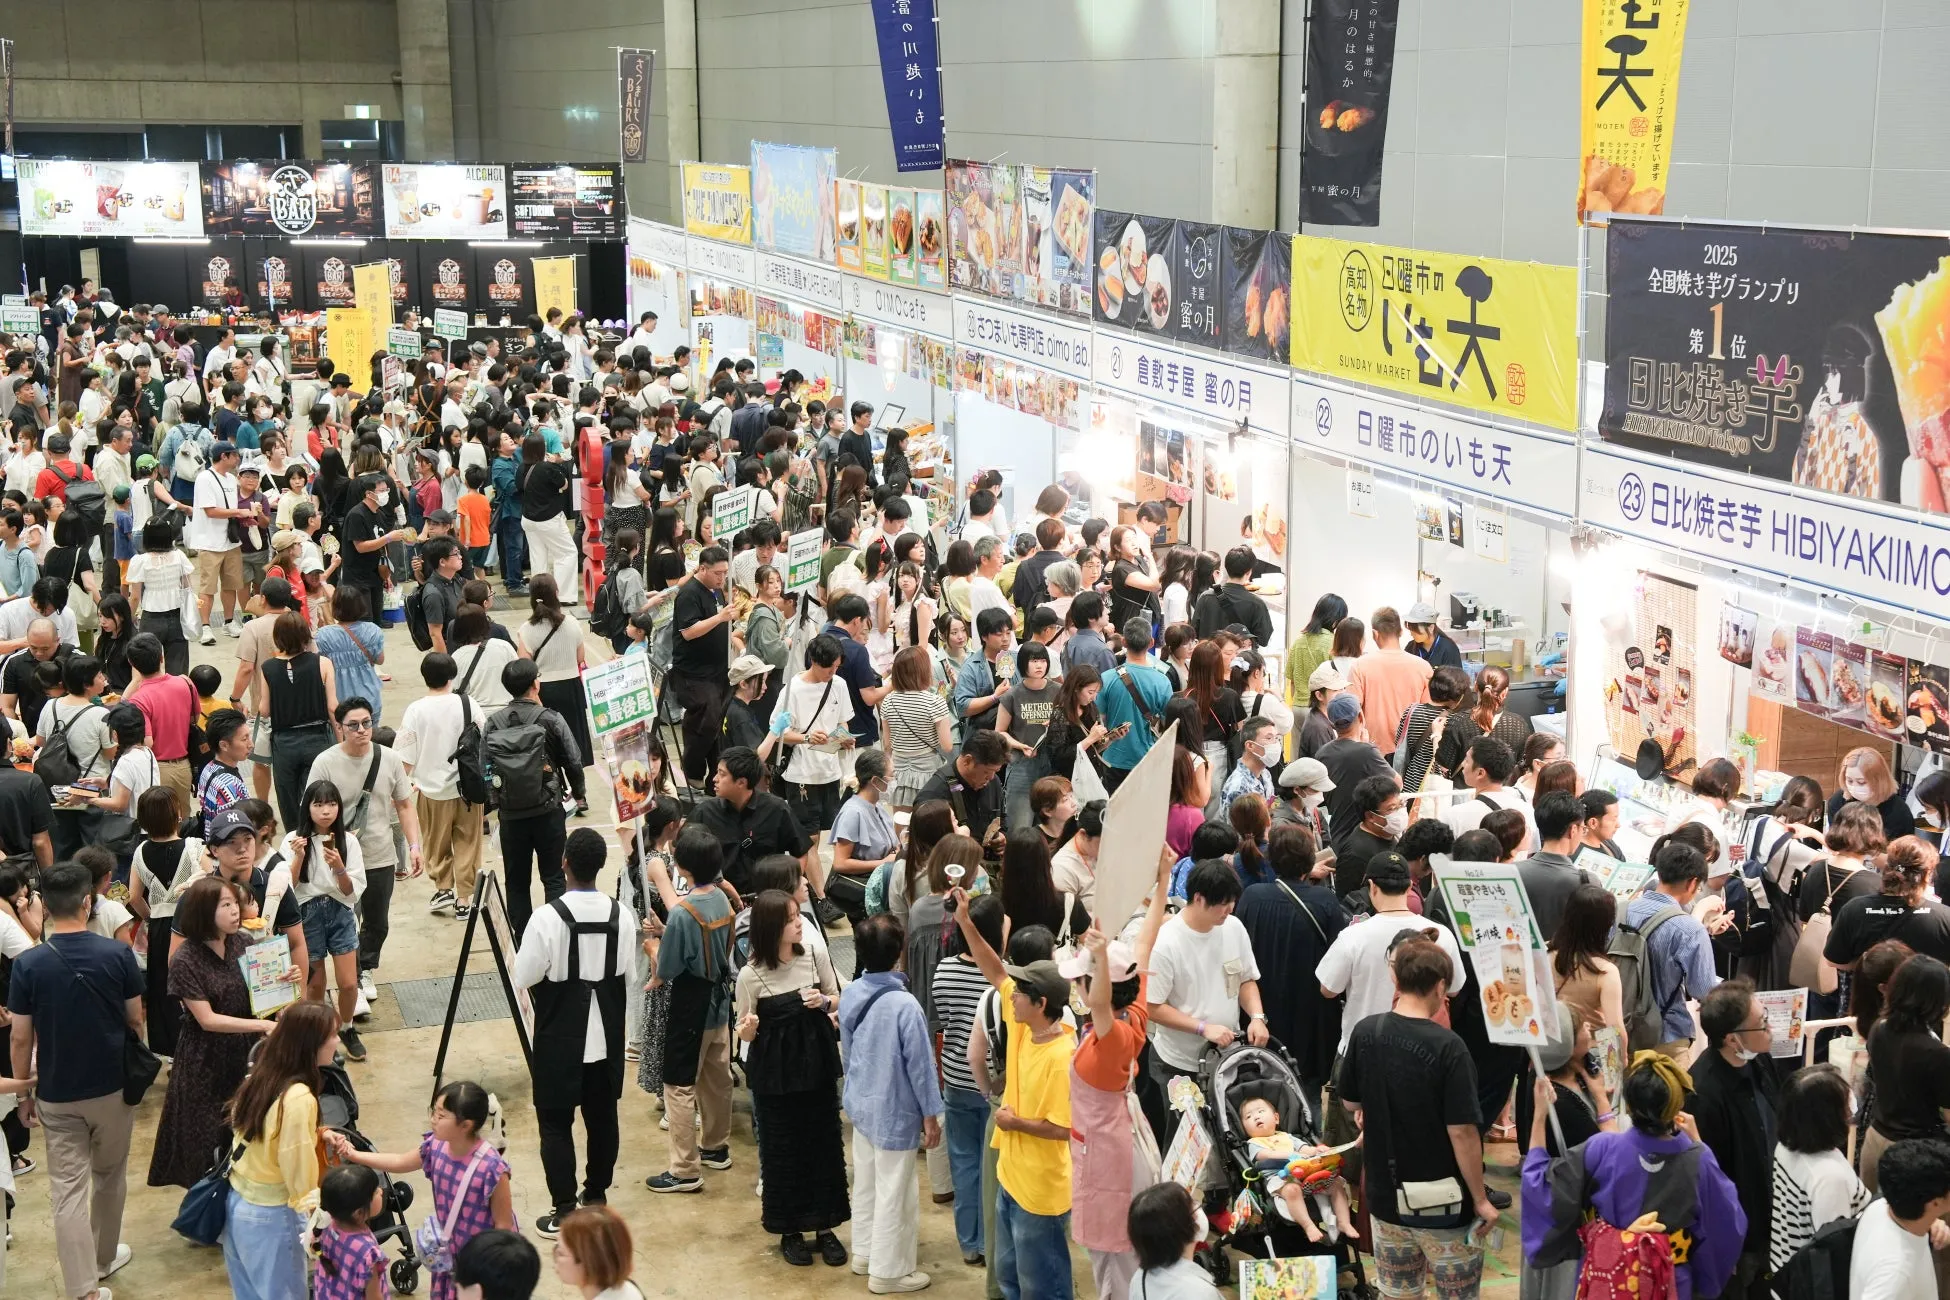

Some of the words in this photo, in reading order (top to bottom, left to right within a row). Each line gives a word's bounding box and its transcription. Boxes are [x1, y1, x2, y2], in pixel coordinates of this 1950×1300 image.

[1342, 9, 1358, 88] 月のはるか
[633, 59, 644, 122] さつまいも
[466, 167, 505, 182] ALCOHOL
[1327, 184, 1361, 199] 蜜の月
[275, 197, 312, 220] BAR
[1703, 244, 1738, 267] 2025
[1345, 265, 1367, 291] 高知
[1382, 255, 1444, 296] 日曜市の
[1648, 266, 1800, 306] 全国焼き芋グランプリ
[876, 290, 926, 322] OIMOcafe
[1180, 300, 1214, 335] 蜜の月
[1345, 294, 1367, 319] 名物
[978, 314, 1045, 356] さつまいも専門店
[1048, 334, 1069, 362] oimo
[1138, 355, 1195, 398] 倉敷芋屋
[1205, 372, 1251, 410] 蜜の月
[1339, 354, 1371, 373] SUNDAY
[1376, 361, 1411, 382] MARKET
[1627, 354, 1804, 452] 日比焼き芋
[1358, 410, 1511, 485] 日曜市のいも天
[721, 511, 747, 530] 最後尾
[1651, 482, 1762, 548] 日比焼き芋
[796, 562, 819, 582] 最後尾
[607, 691, 652, 722] 最後尾
